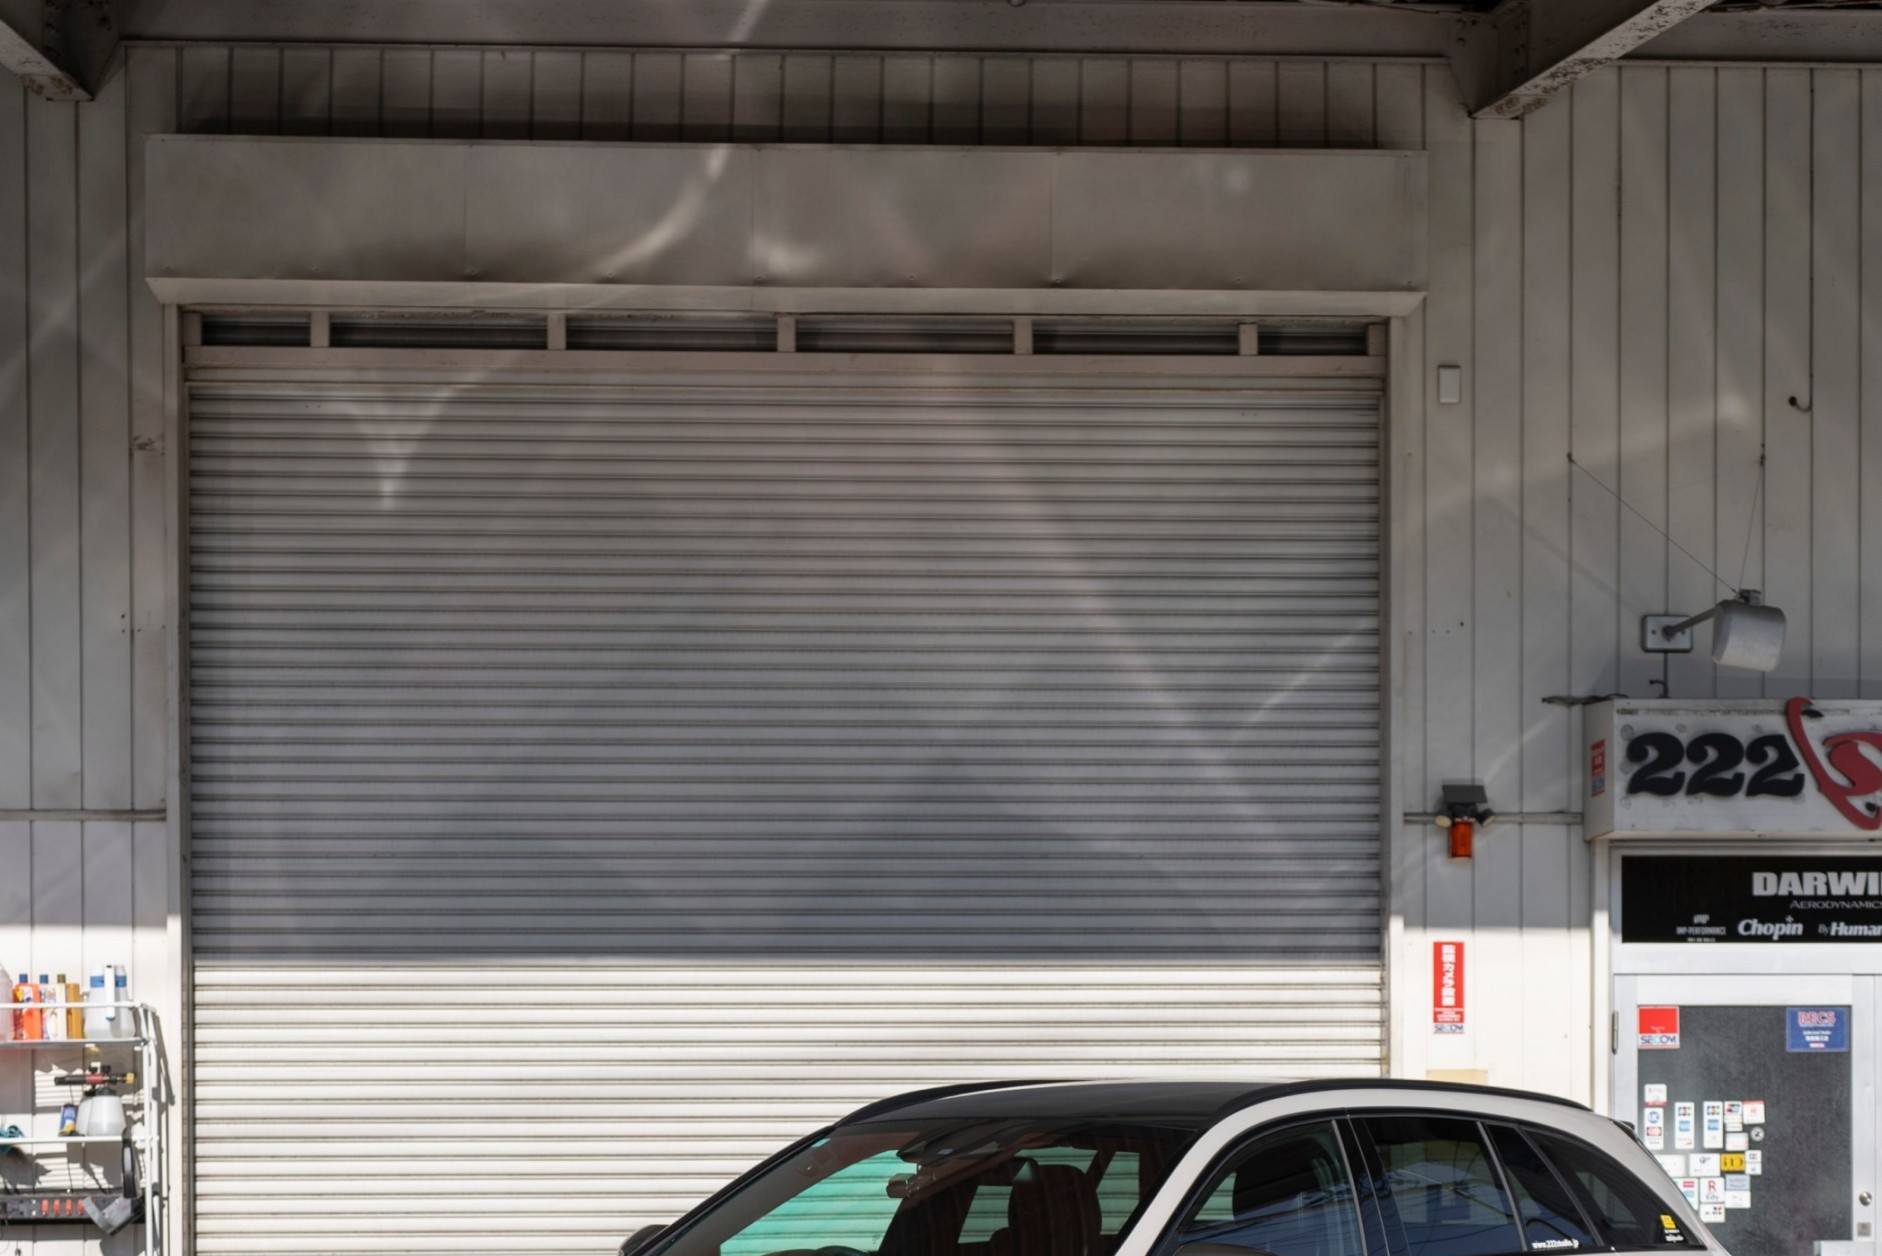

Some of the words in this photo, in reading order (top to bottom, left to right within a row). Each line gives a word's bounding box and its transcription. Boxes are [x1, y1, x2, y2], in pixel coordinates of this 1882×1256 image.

[1626, 731, 1805, 797] 222
[1752, 872, 1882, 896] DARWI
[1790, 900, 1882, 909] AERODYNAMIC
[1738, 915, 1803, 940] Chopin
